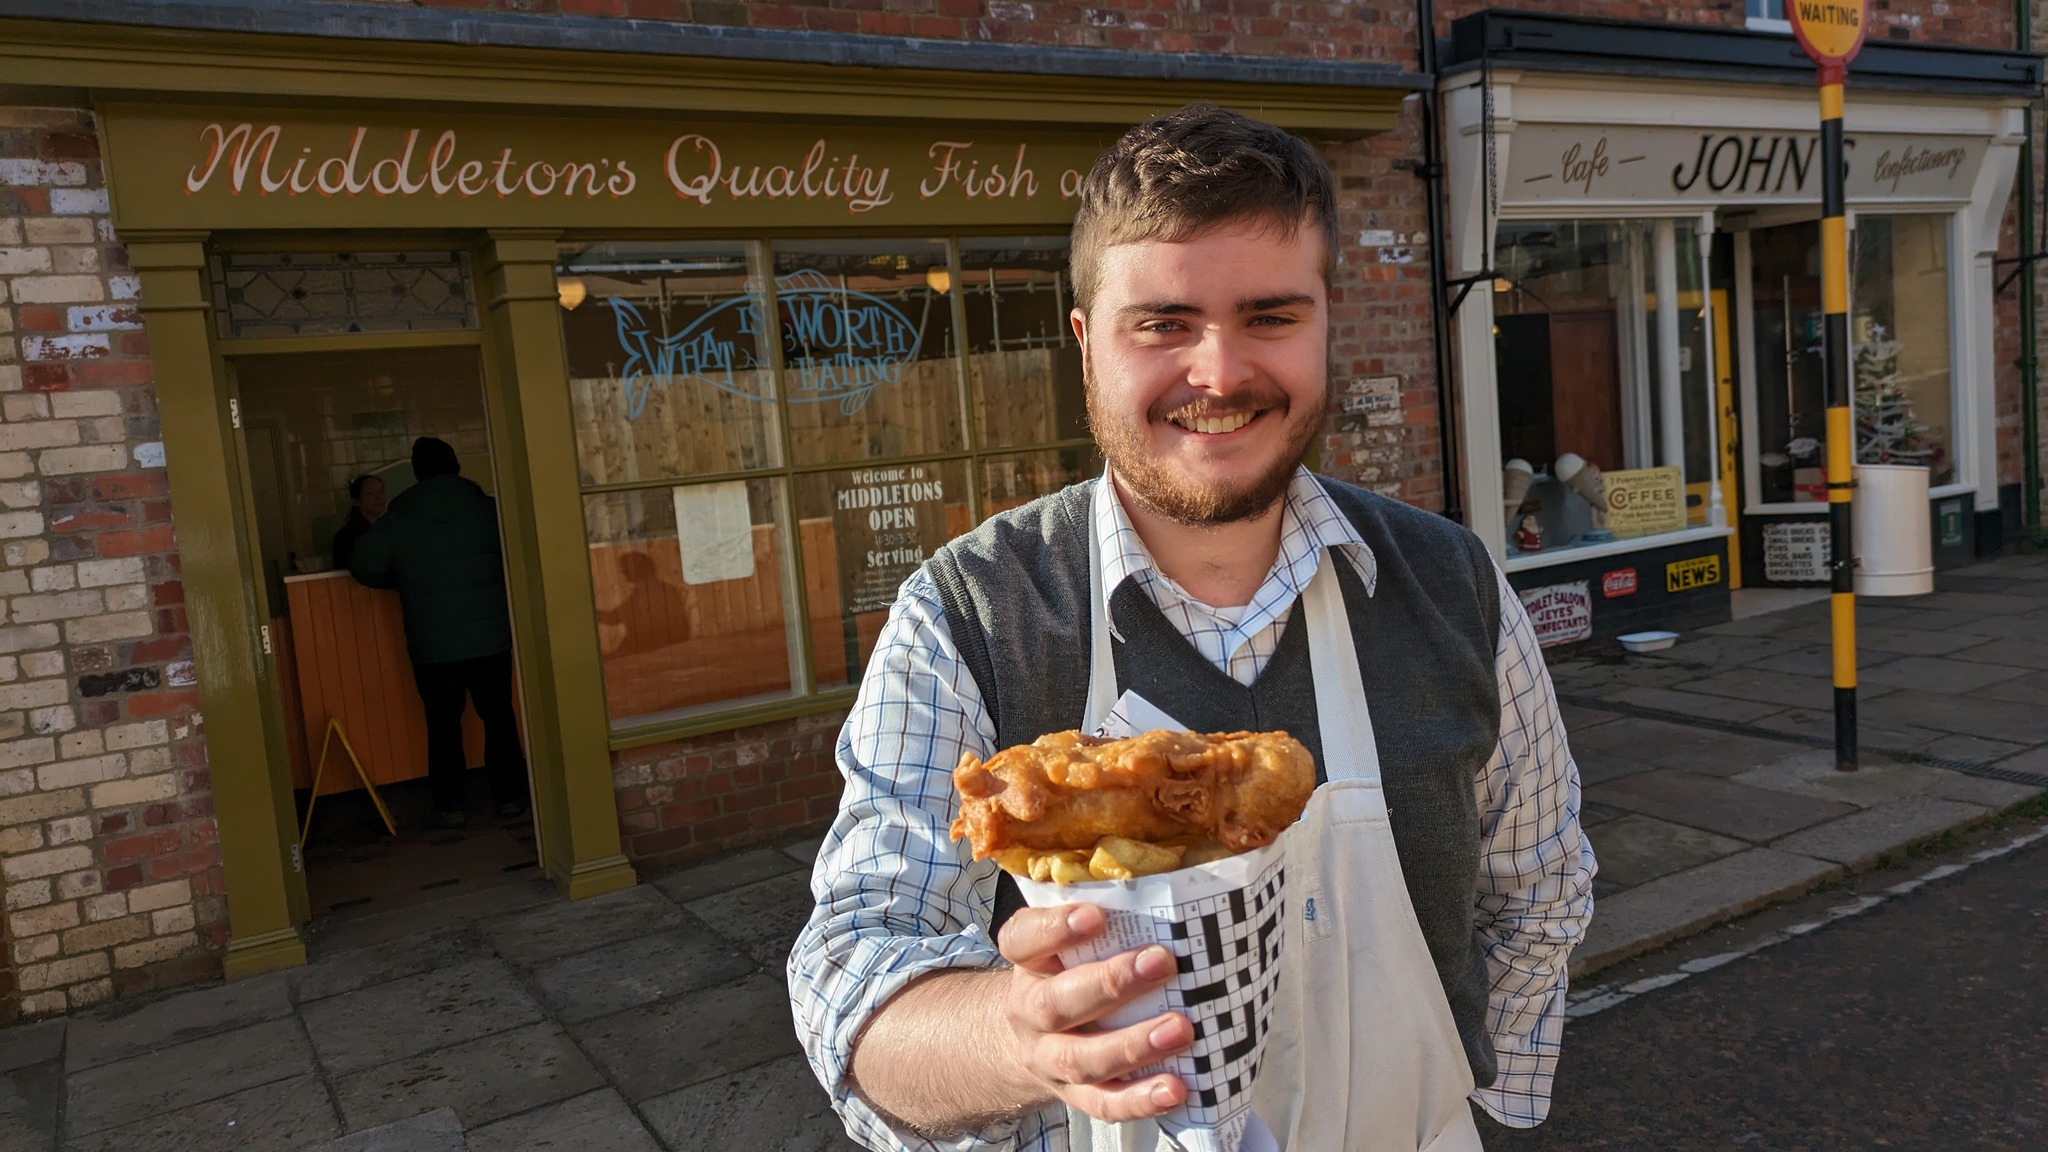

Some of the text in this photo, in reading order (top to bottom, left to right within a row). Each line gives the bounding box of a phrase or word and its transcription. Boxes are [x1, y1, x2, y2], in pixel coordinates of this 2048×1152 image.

[1799, 1, 1859, 27] WAITING
[185, 123, 636, 197] Middleton's
[664, 133, 893, 214] Quality
[919, 140, 1038, 200] Fish
[630, 294, 909, 388] WHAT IS WORTH
[798, 354, 901, 391] EATING
[852, 466, 923, 485] Welcome to
[838, 480, 943, 510] MIDDLETONS
[1608, 487, 1675, 511] COFFEE
[869, 507, 916, 532] OPEN
[867, 545, 924, 568] Serving
[1669, 563, 1717, 590] NEWS
